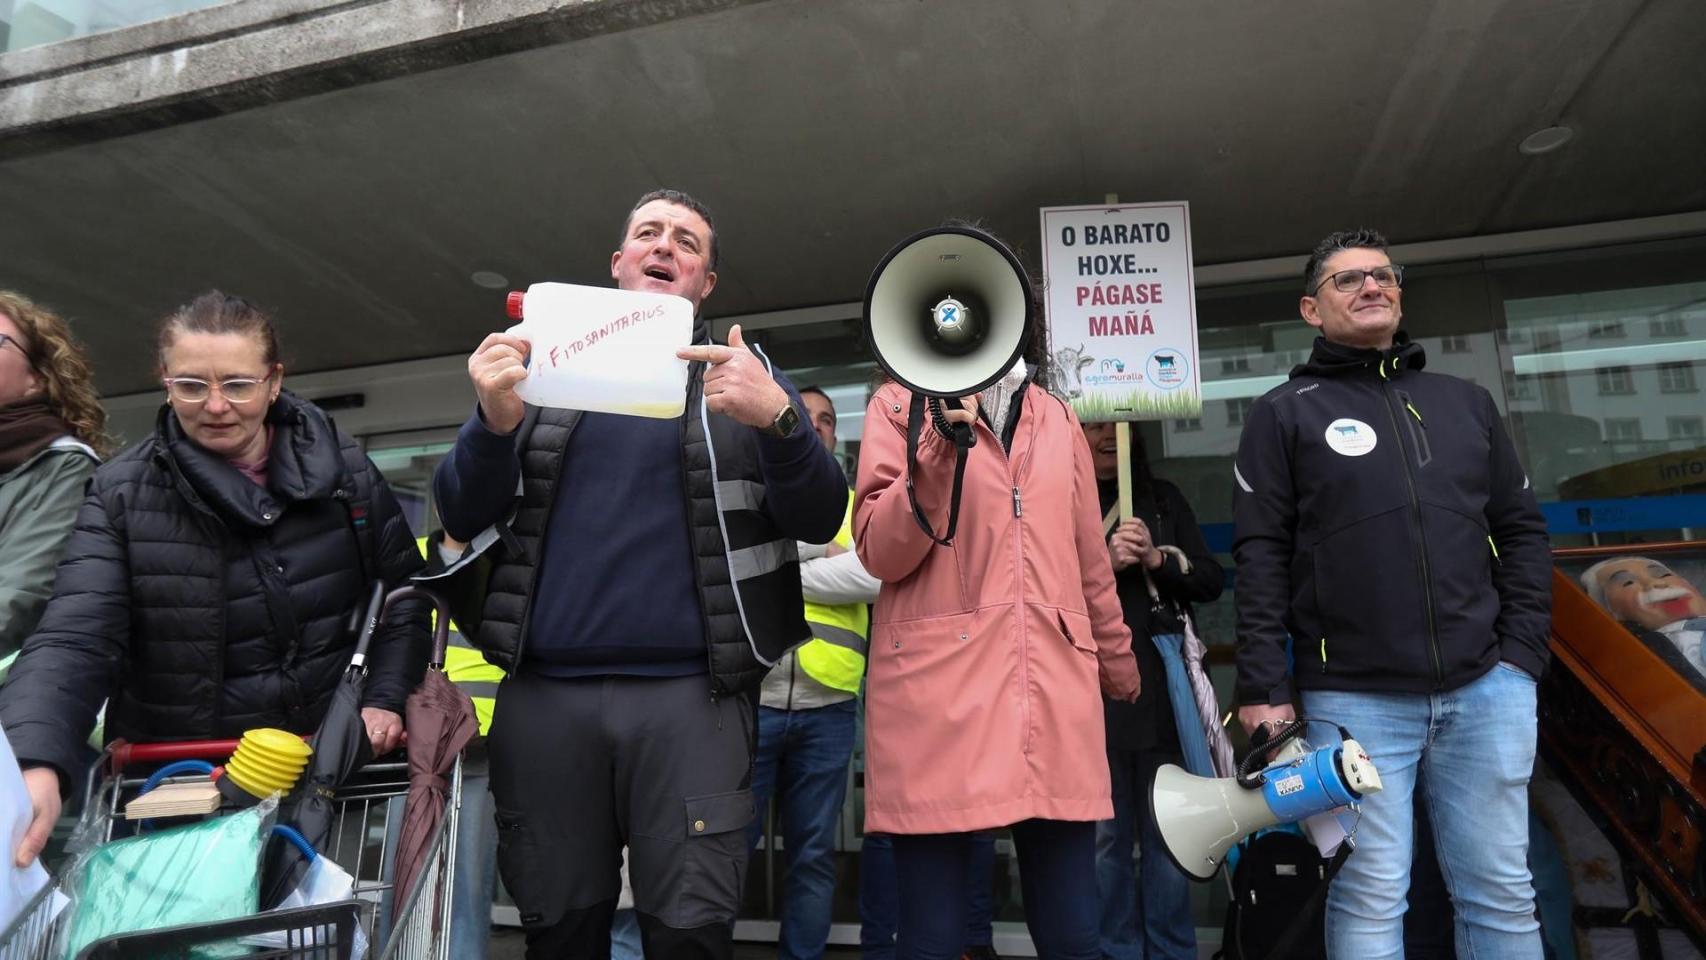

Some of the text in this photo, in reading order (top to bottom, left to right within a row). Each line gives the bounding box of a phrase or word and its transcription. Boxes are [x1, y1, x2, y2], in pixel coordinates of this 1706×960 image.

[1062, 222, 1170, 246] O BARATO
[1078, 254, 1158, 276] HOXE...
[1076, 281, 1163, 306] PÁGASE
[1089, 309, 1155, 337] MAÑÁ
[549, 305, 665, 368] FITOSANITARIUS
